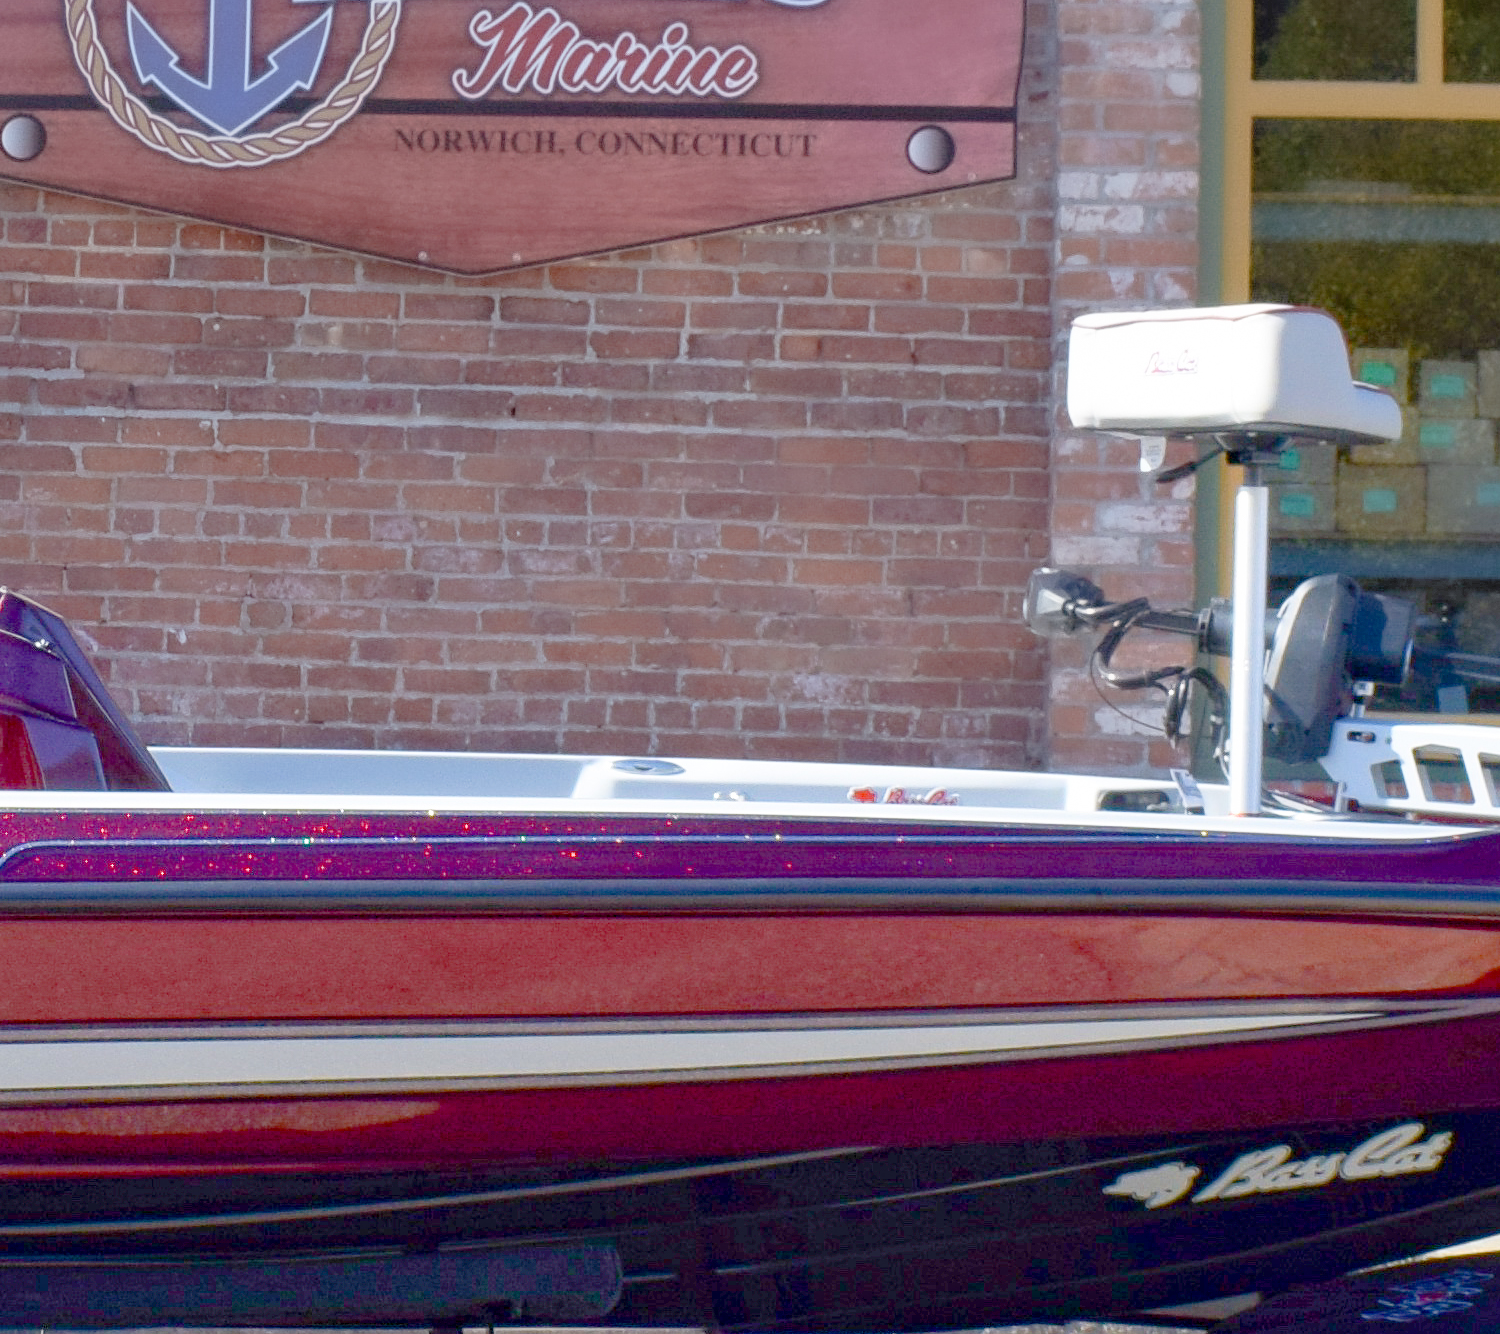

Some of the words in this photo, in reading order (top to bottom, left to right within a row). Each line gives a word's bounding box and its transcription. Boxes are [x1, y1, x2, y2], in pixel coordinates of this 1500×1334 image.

[452, 2, 758, 98] Marine
[396, 128, 566, 155] NORWICH,
[575, 129, 817, 158] CONNECTICUT
